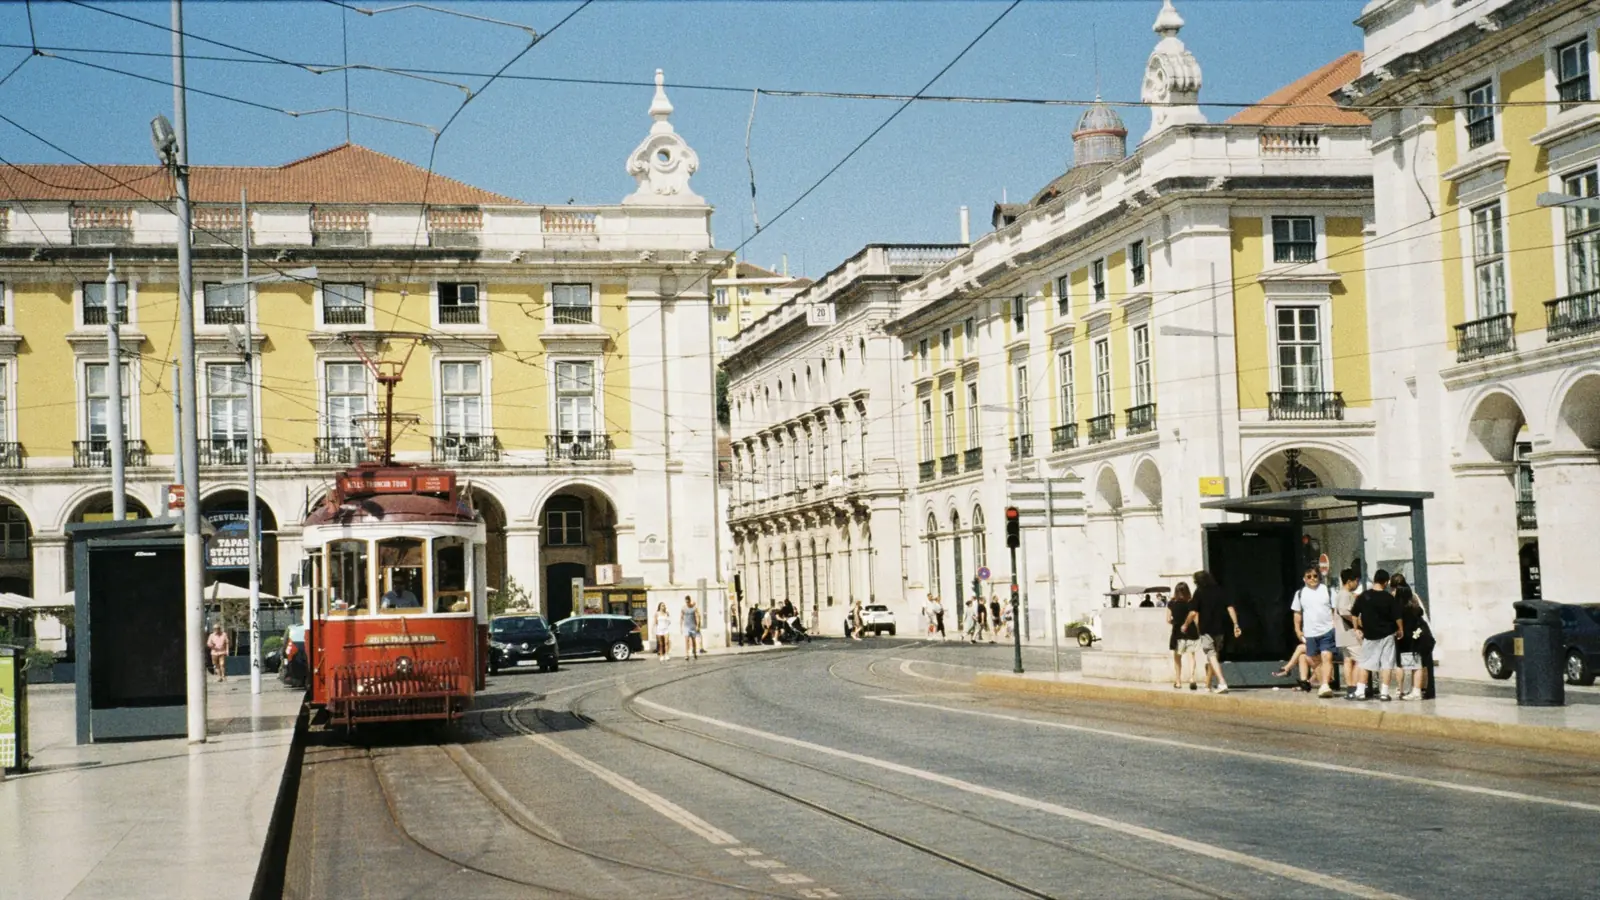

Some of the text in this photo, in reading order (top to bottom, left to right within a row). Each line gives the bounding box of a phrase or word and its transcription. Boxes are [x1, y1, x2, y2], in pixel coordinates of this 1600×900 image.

[816, 308, 826, 317] 20
[392, 480, 408, 488] TOUR
[217, 538, 249, 548] TAPAS
[210, 547, 249, 557] STEAKS
[211, 556, 249, 566] SEAFOO
